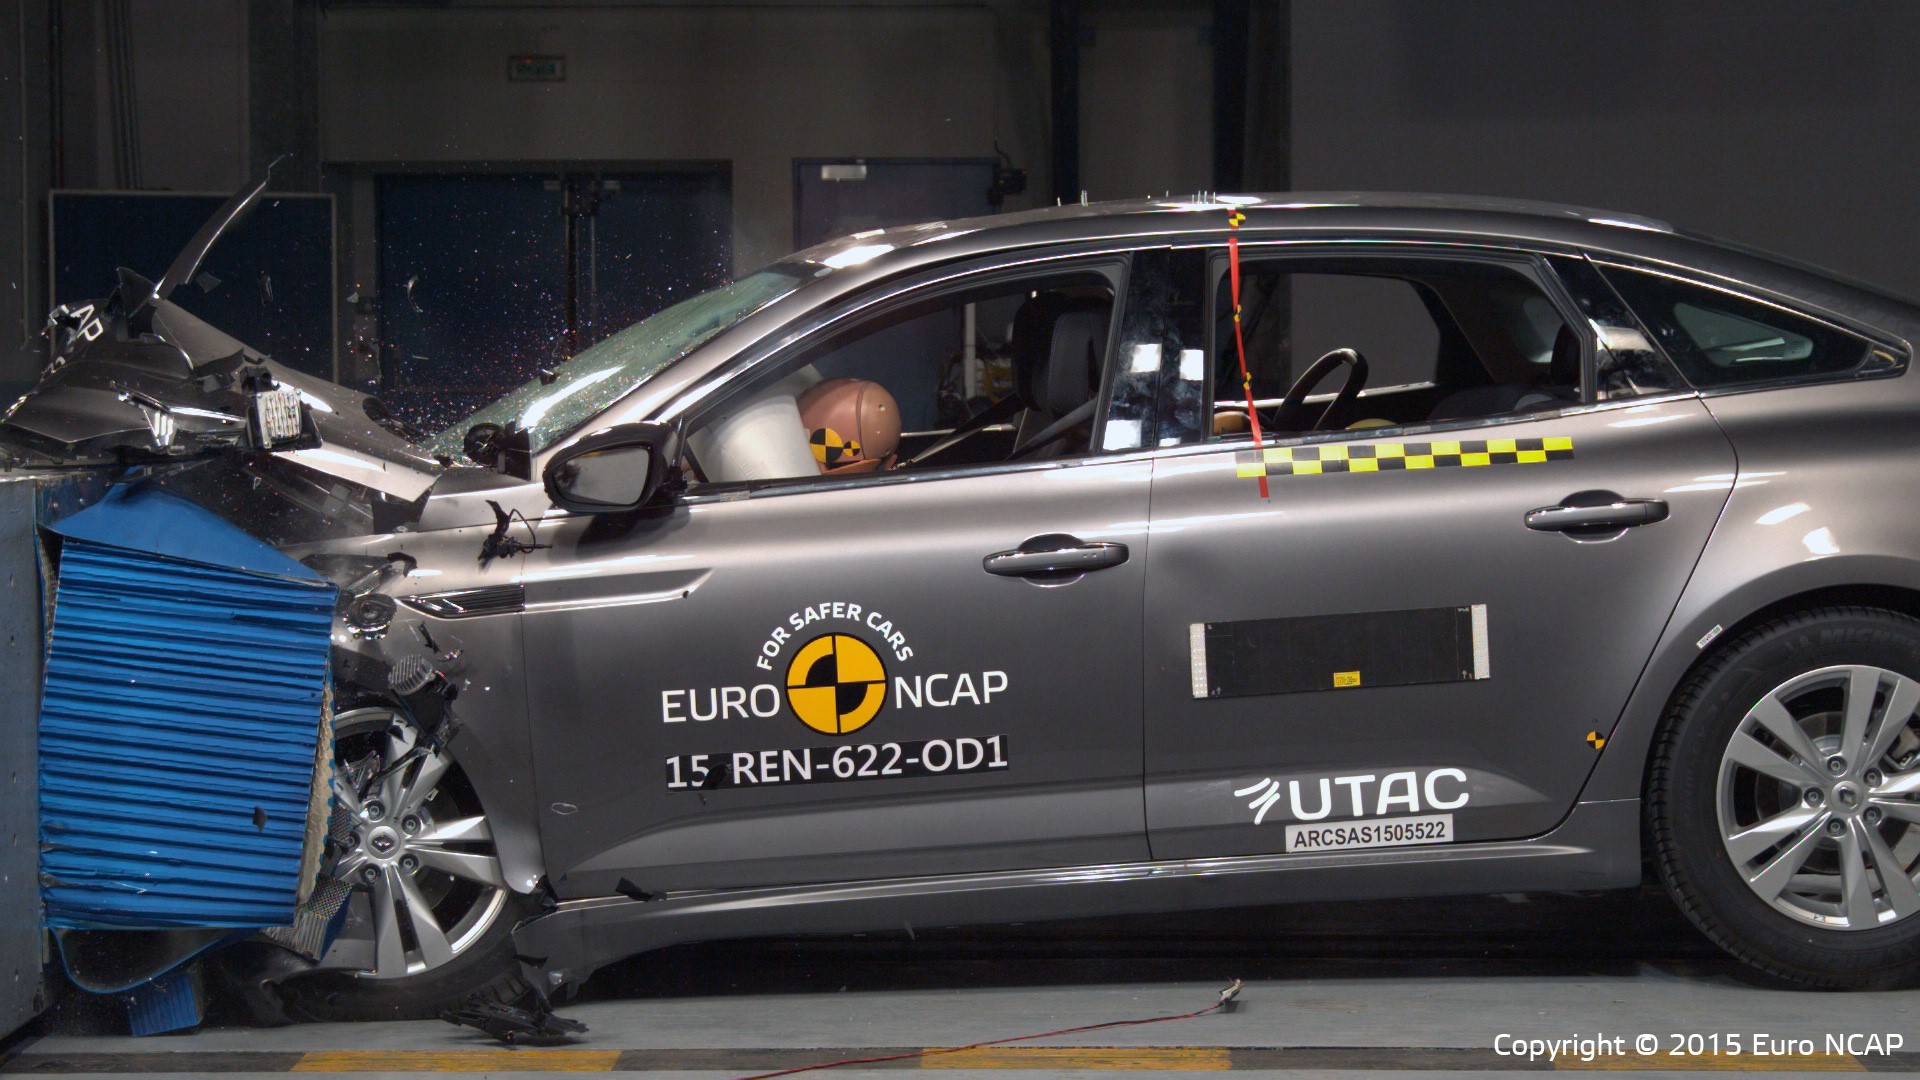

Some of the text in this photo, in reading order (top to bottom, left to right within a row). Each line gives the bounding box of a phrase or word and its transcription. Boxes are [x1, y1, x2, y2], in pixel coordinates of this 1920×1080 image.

[756, 602, 914, 671] FOR SAFER CARS
[661, 671, 1008, 722] EURO NCAP
[666, 736, 1008, 788] 15REN-622-OD1
[1289, 768, 1470, 820] UTAC
[1294, 822, 1446, 848] ARCSAS1505522
